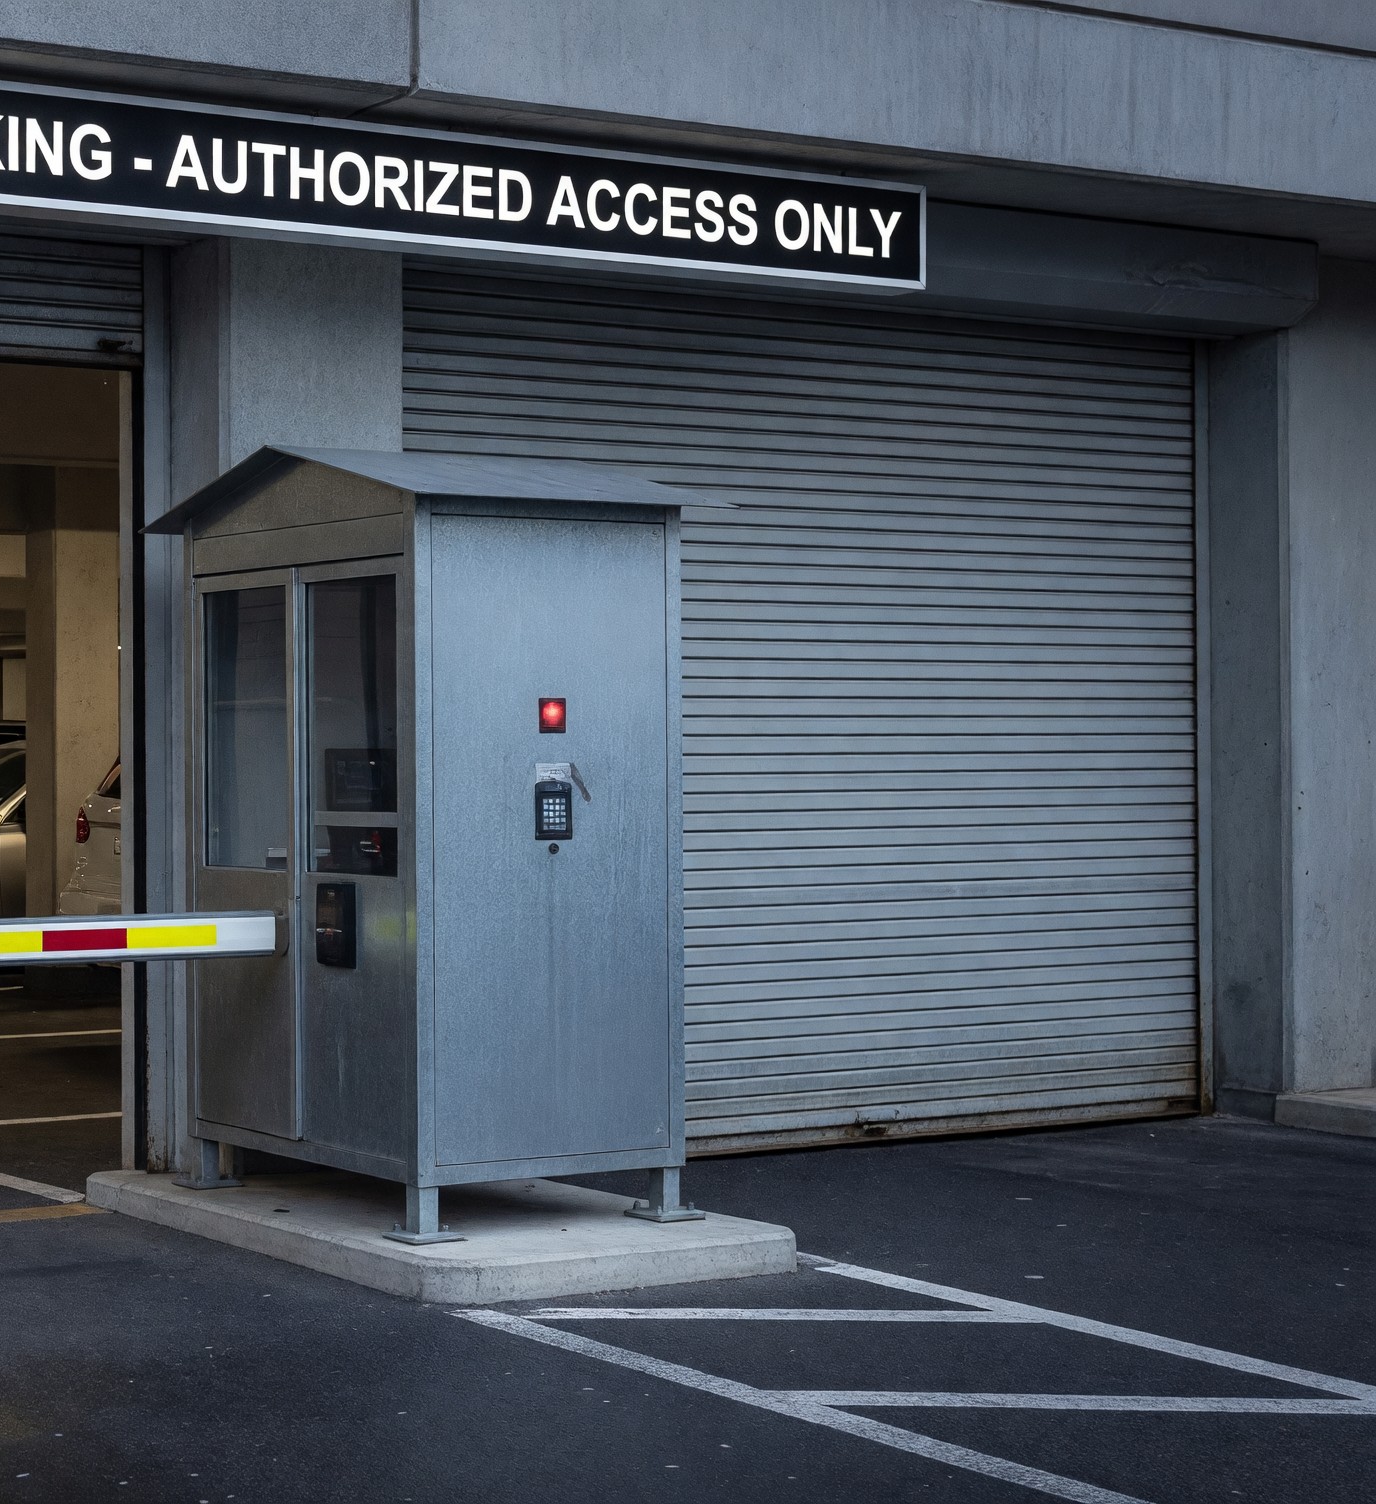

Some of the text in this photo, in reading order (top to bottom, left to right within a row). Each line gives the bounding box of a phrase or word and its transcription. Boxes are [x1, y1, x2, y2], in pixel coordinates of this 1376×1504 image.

[165, 134, 533, 222] AUTHORIZED
[546, 175, 758, 246] ACCESS
[774, 199, 903, 258] ONLY
